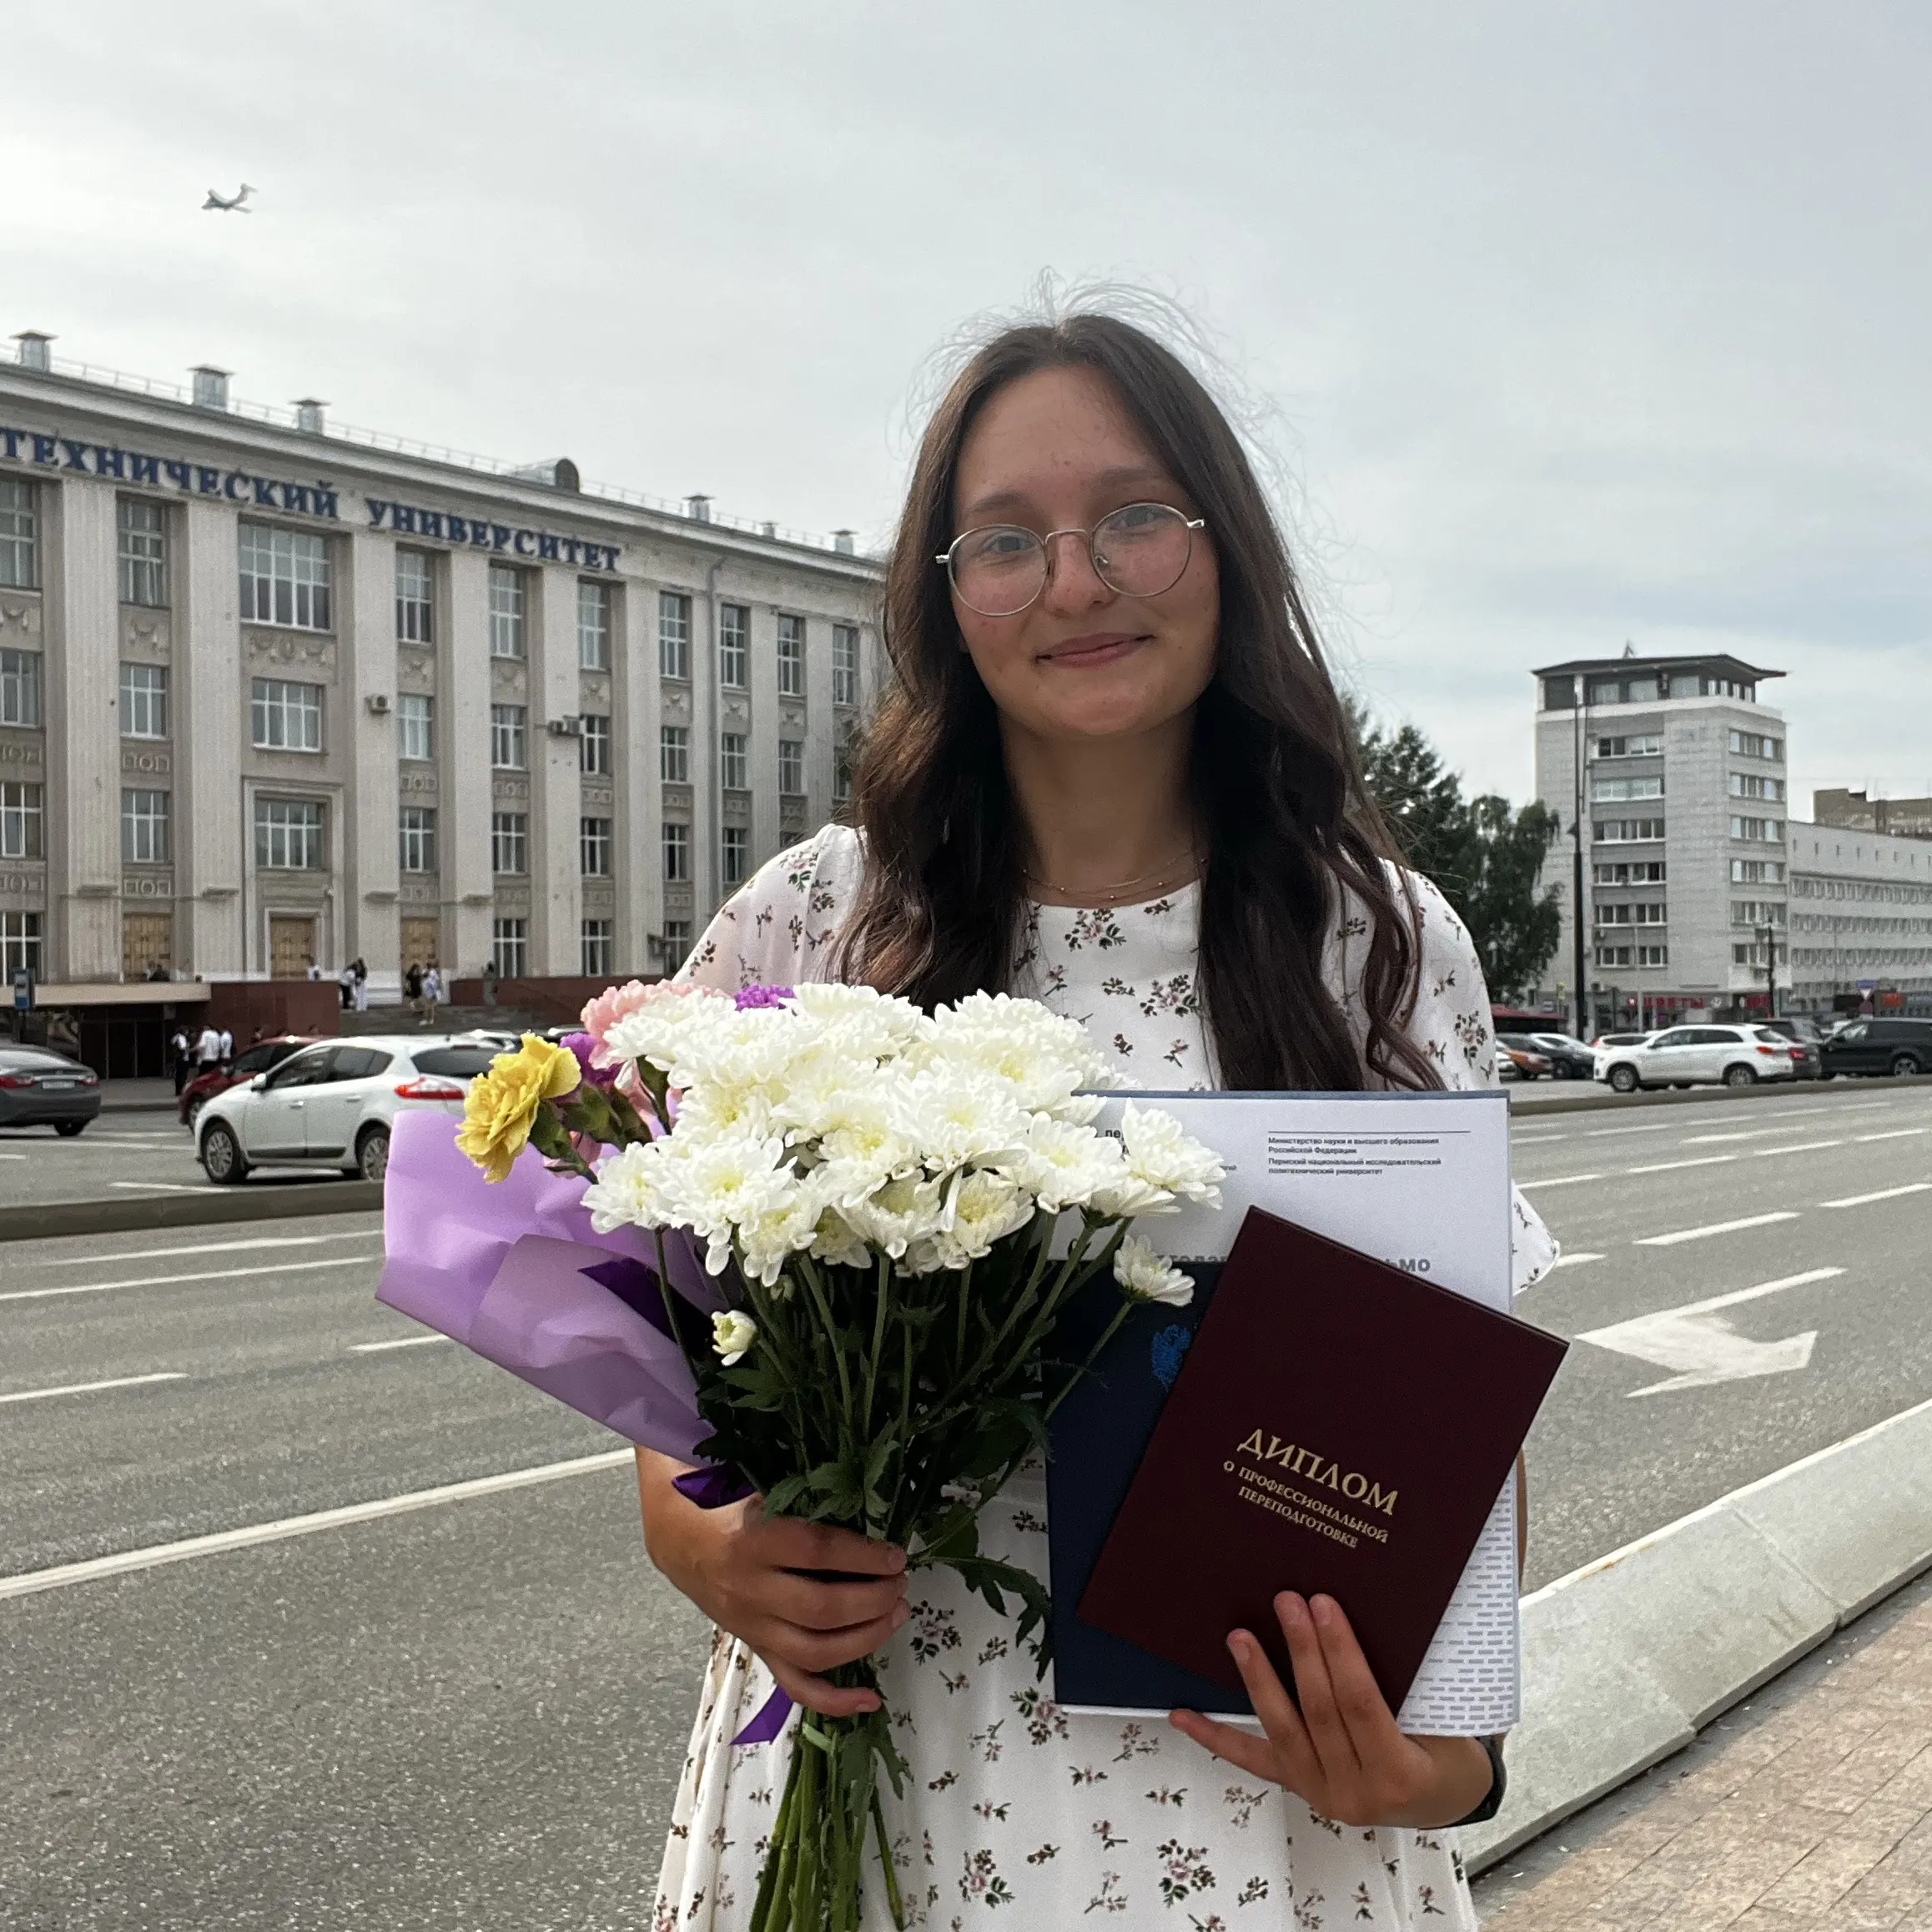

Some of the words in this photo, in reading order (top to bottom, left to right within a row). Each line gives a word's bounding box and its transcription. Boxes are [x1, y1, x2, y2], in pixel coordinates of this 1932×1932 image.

[0, 426, 340, 519] ТЕХНИЧЕСКИЙ
[365, 497, 621, 572] УНИВЕРСИТЕТ
[1390, 1137, 1439, 1145] образования
[1236, 1428, 1399, 1516] ДИПЛОМ
[1238, 1466, 1390, 1544] ПРОФЕССИОНАЛЬНОЙ
[1238, 1485, 1360, 1549] ПЕРЕПОДГОТОВКЕ
